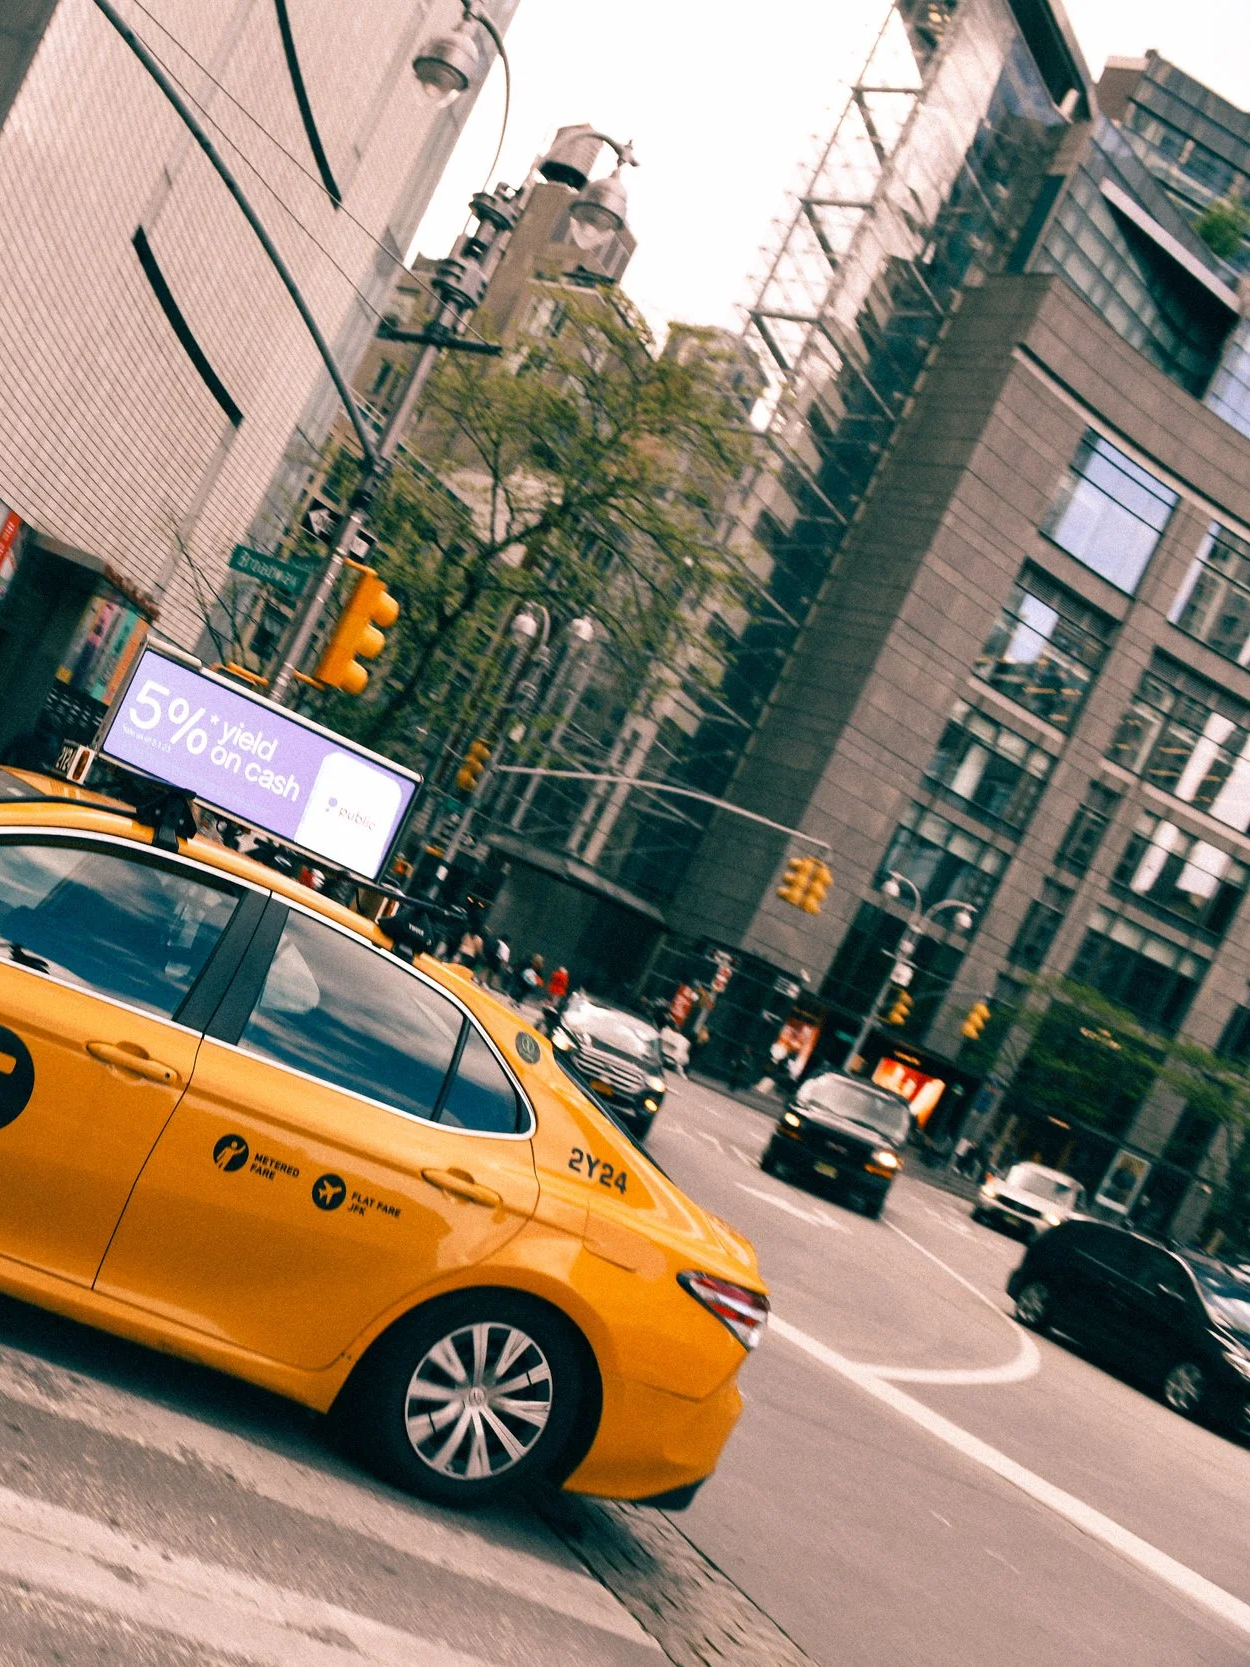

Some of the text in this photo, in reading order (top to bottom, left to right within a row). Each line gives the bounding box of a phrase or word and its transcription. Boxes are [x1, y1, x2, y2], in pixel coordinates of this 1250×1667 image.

[216, 720, 279, 762] yield
[210, 743, 301, 801] on cash
[338, 806, 376, 831] public
[250, 1164, 276, 1182] FARE
[254, 1152, 300, 1179] METERED
[568, 1147, 627, 1195] 2Y24
[348, 1203, 367, 1216] JFK
[351, 1191, 402, 1218] FLAT FARE
